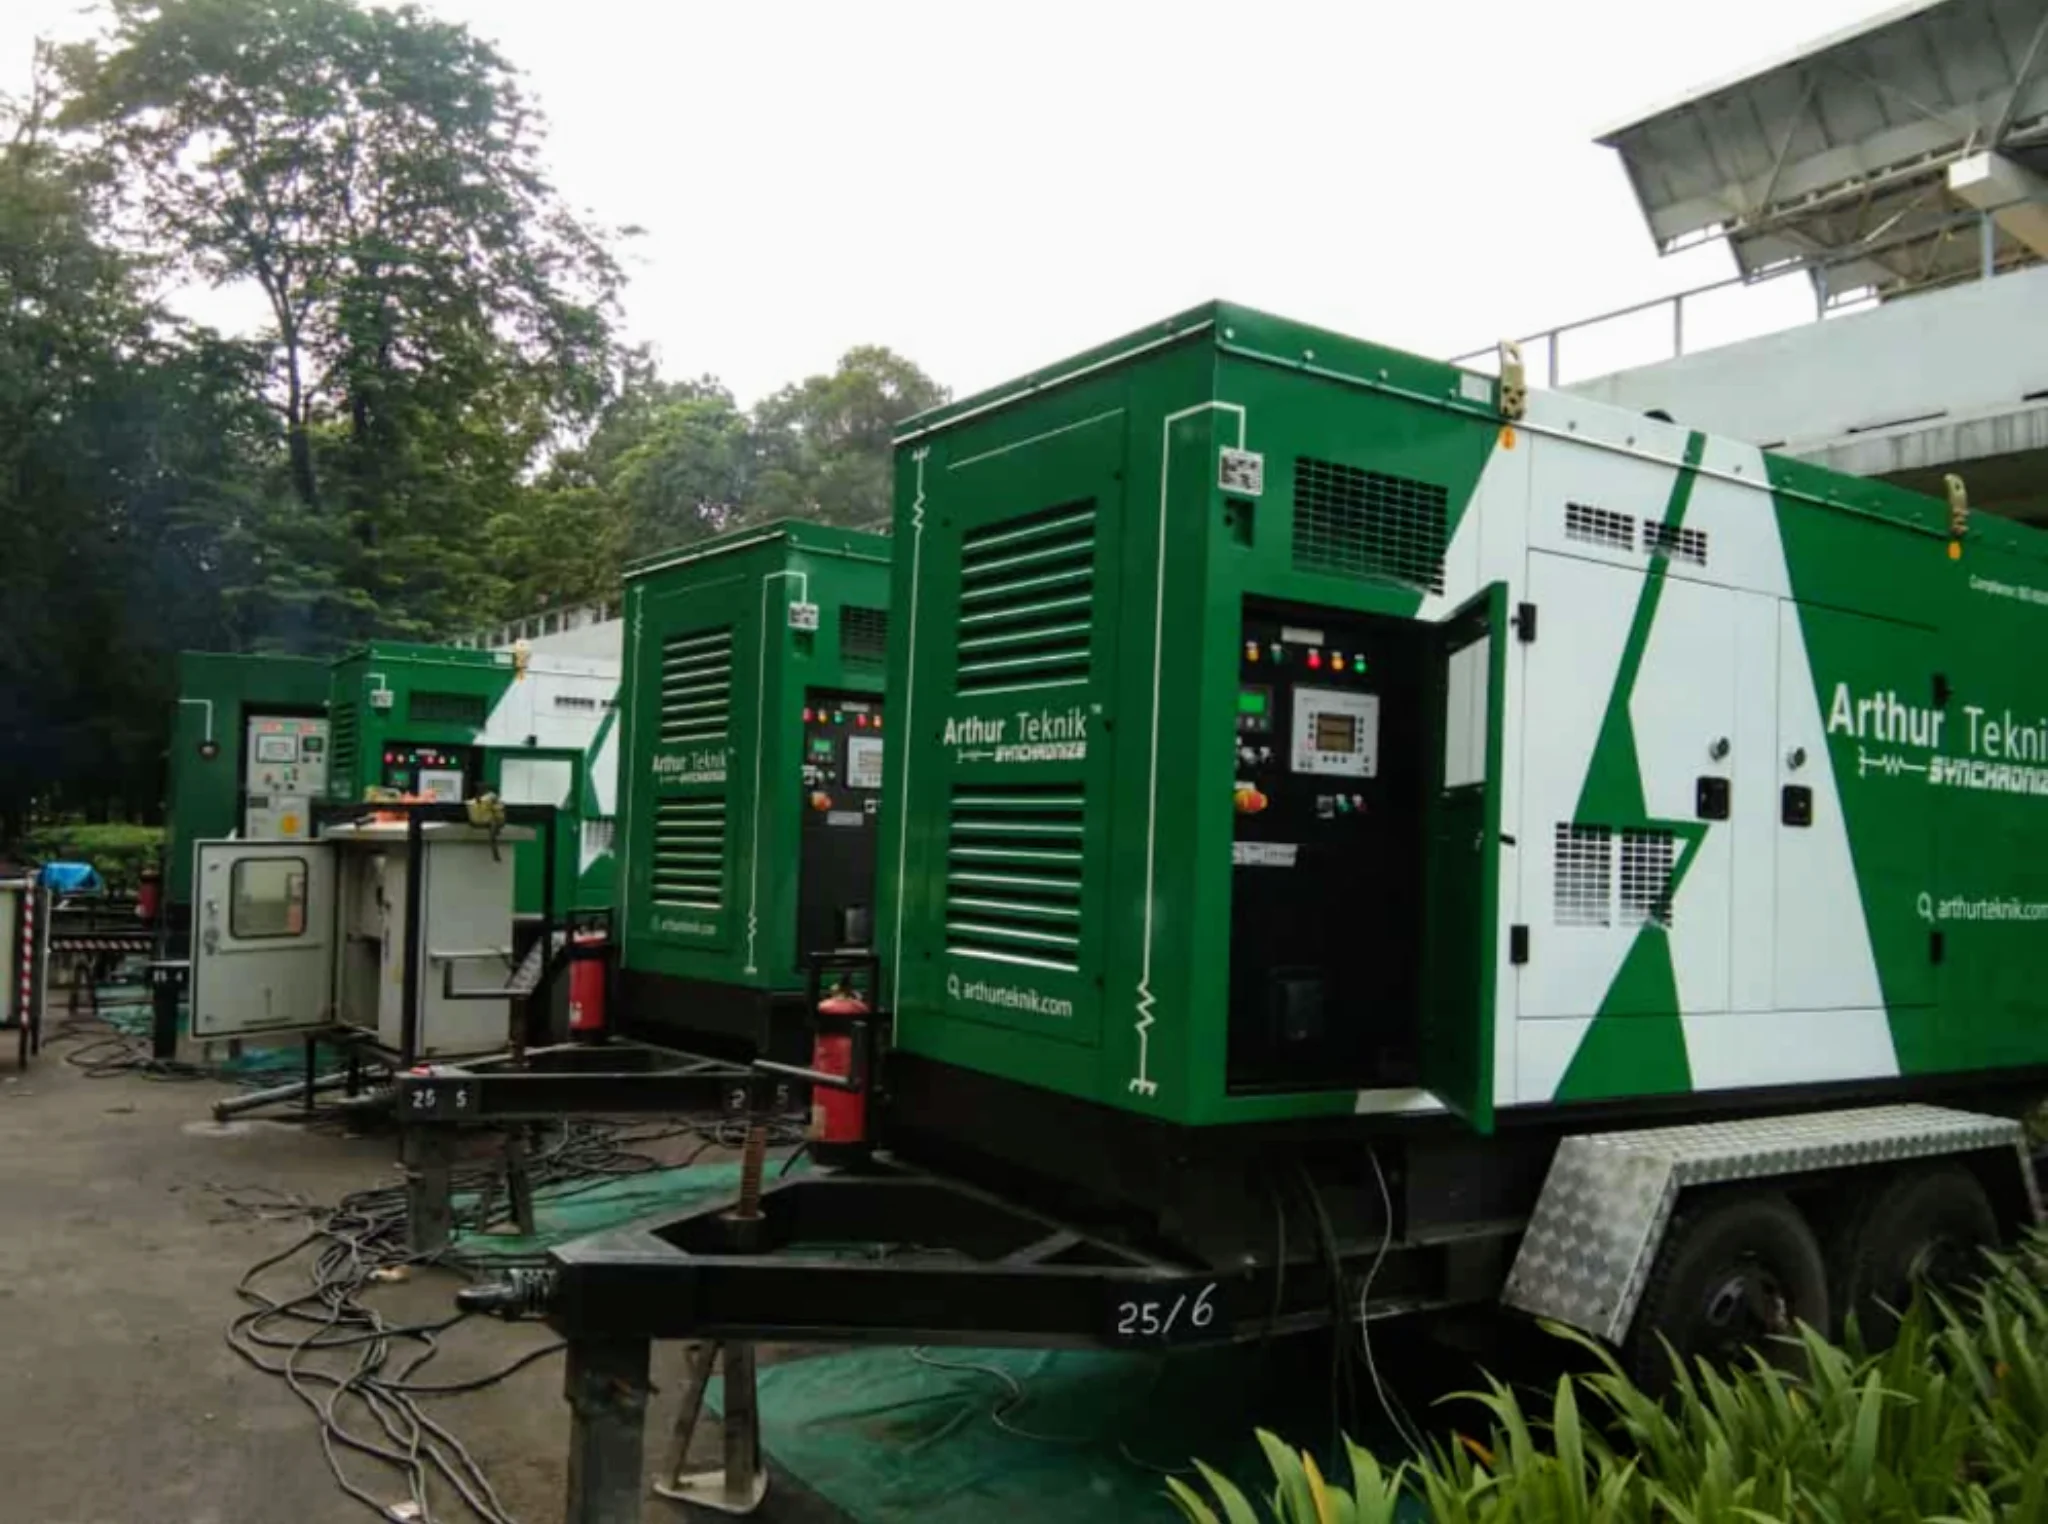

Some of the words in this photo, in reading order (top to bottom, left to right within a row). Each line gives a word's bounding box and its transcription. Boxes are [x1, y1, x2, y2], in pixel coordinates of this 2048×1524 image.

[943, 716, 1006, 745] Arthur
[1016, 706, 1087, 741] Teknik
[1827, 682, 1945, 748] Arthur
[964, 980, 1073, 1017] arthurteknik.com
[1118, 1282, 1217, 1334] 25/6
